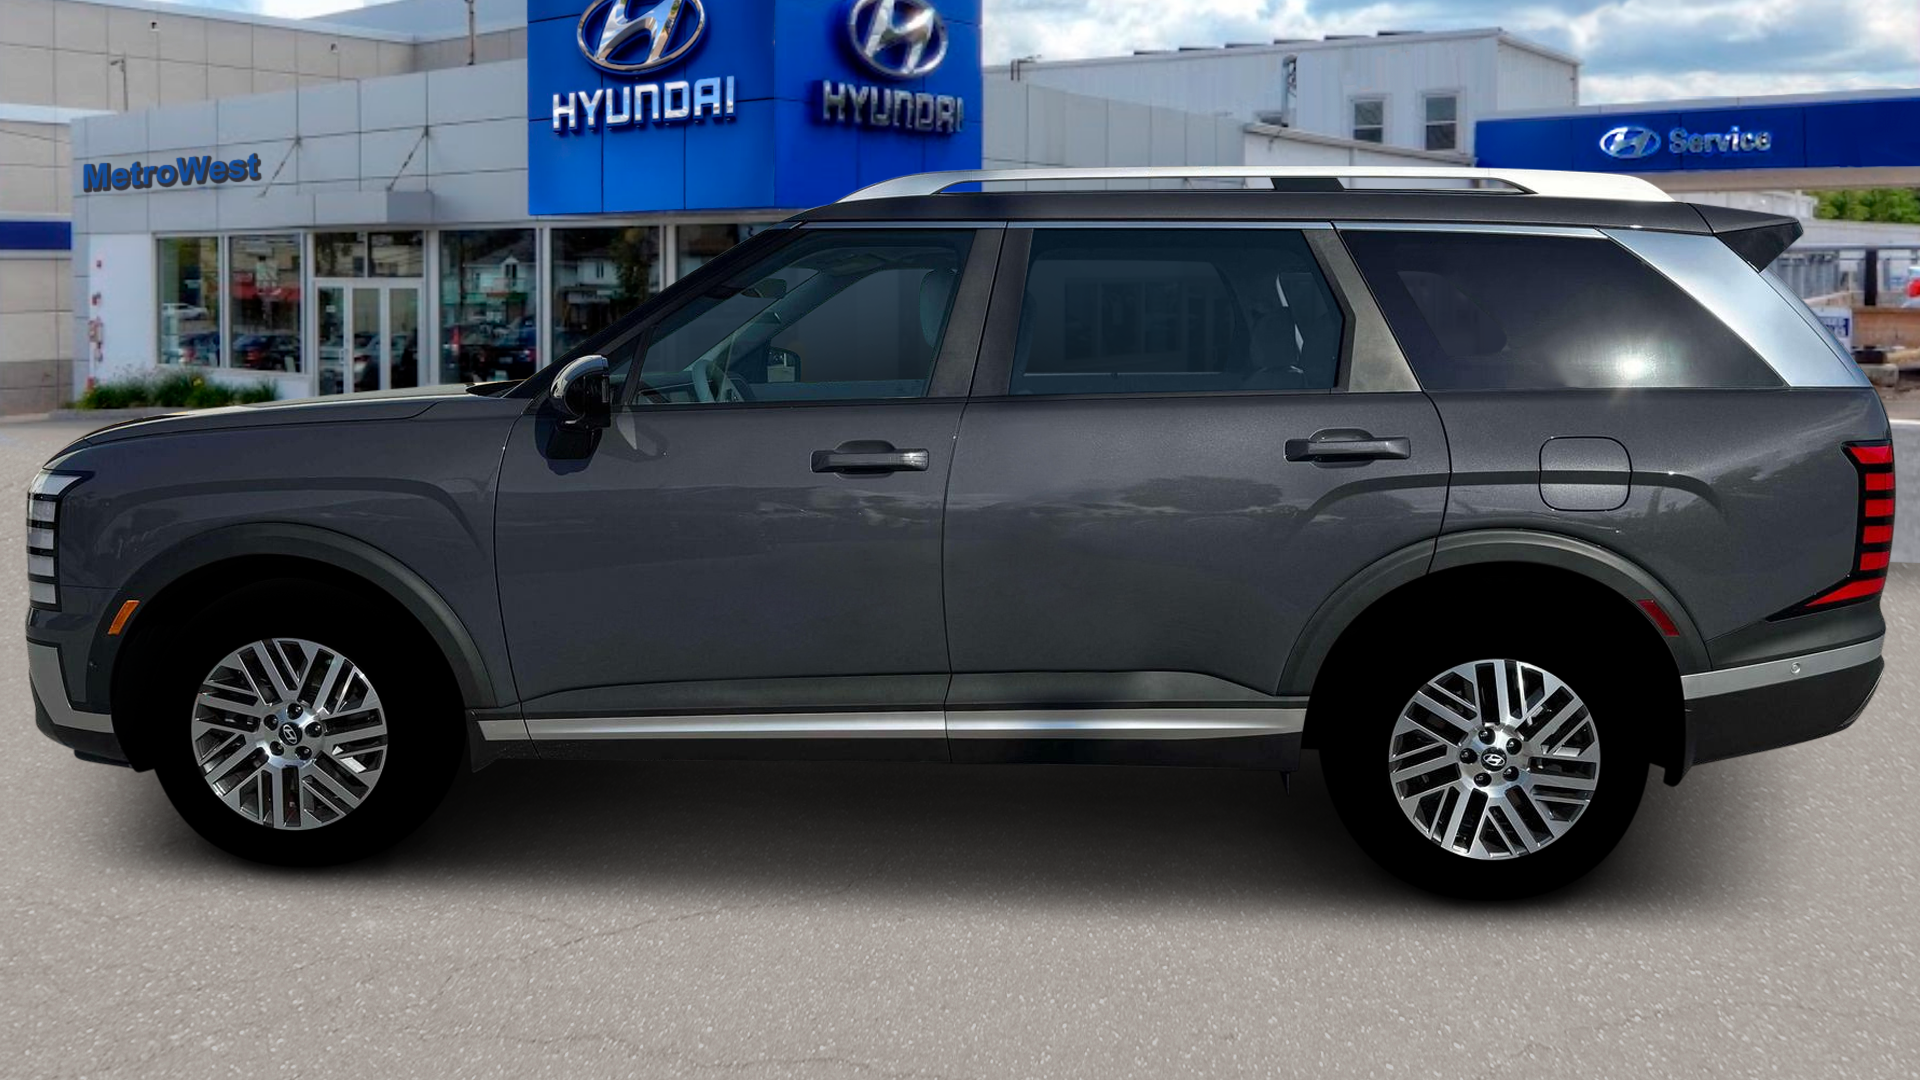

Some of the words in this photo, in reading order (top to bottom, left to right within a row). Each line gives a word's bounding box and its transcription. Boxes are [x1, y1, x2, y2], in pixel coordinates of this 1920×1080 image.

[552, 75, 736, 131] HYUNDAI
[822, 80, 965, 132] HYUNDAI
[1669, 125, 1772, 153] Service
[83, 153, 262, 193] MetroWest
